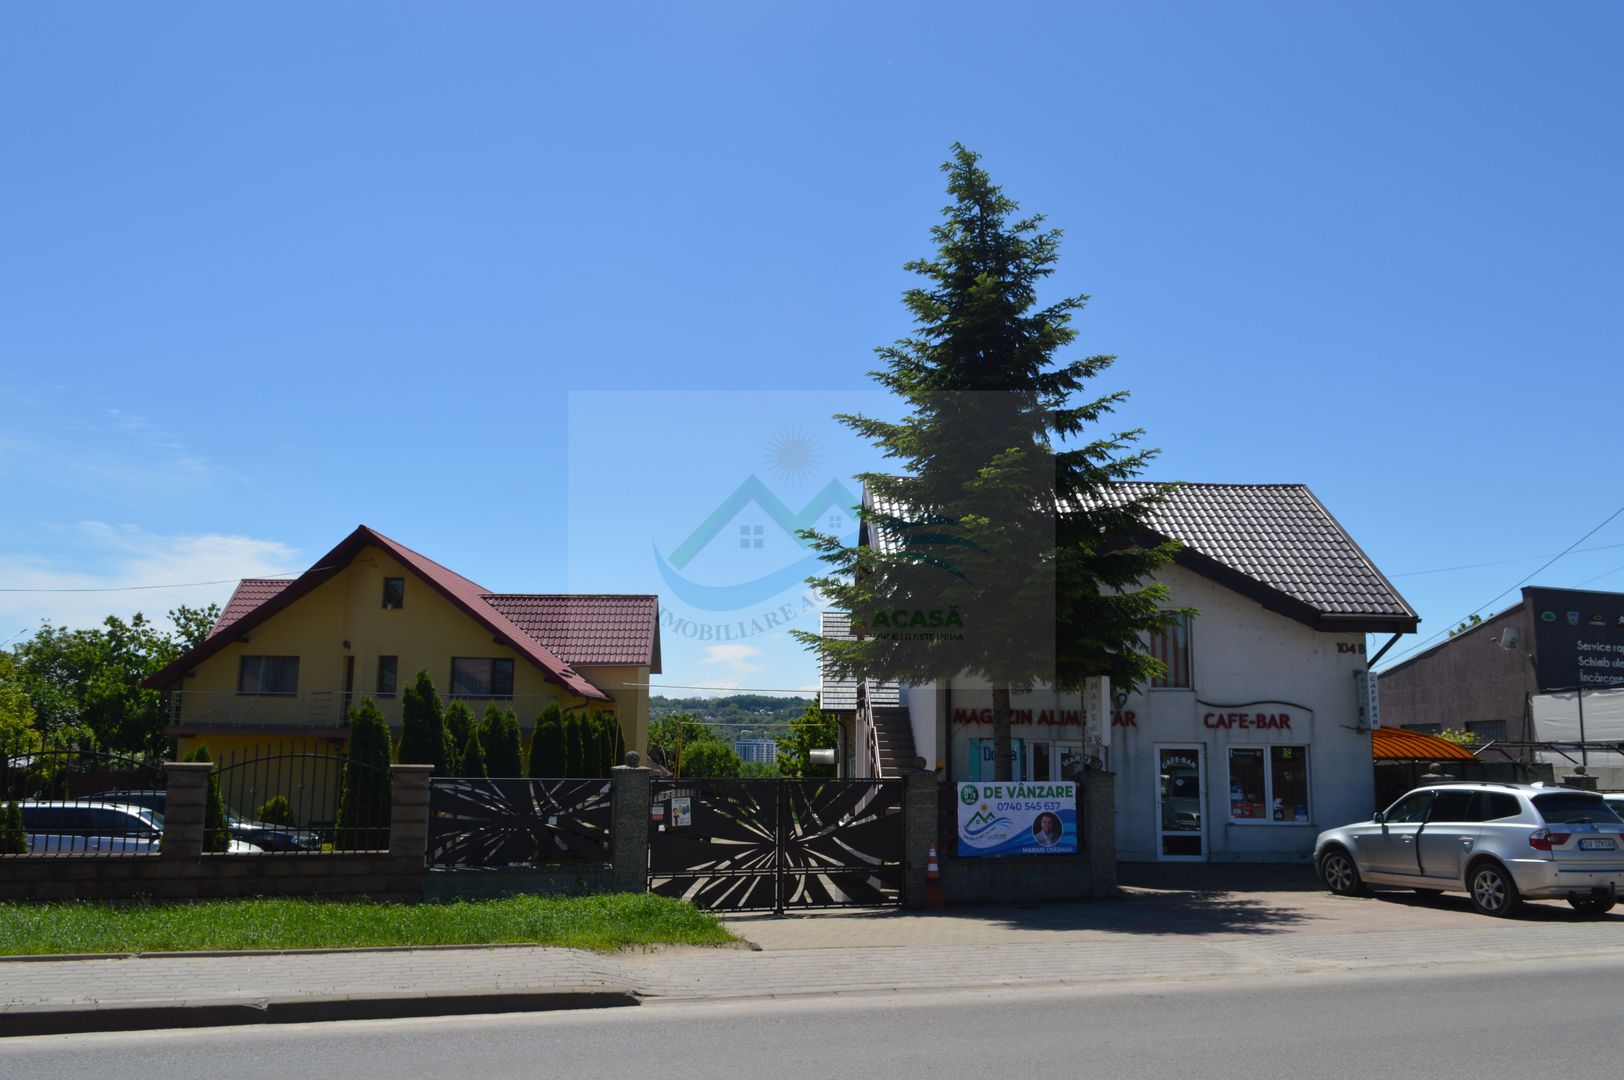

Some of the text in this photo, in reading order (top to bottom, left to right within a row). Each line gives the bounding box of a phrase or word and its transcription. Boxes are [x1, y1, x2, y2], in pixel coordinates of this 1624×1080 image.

[1336, 642, 1356, 654] 104
[1577, 640, 1611, 651] Service
[1578, 656, 1610, 667] Schimb
[953, 708, 1137, 727] MAGZIN ALIMEAR
[1204, 713, 1292, 729] CAFE-BAR
[983, 783, 1073, 799] DE VÂNZARE
[996, 801, 1061, 811] 0740 545 637
